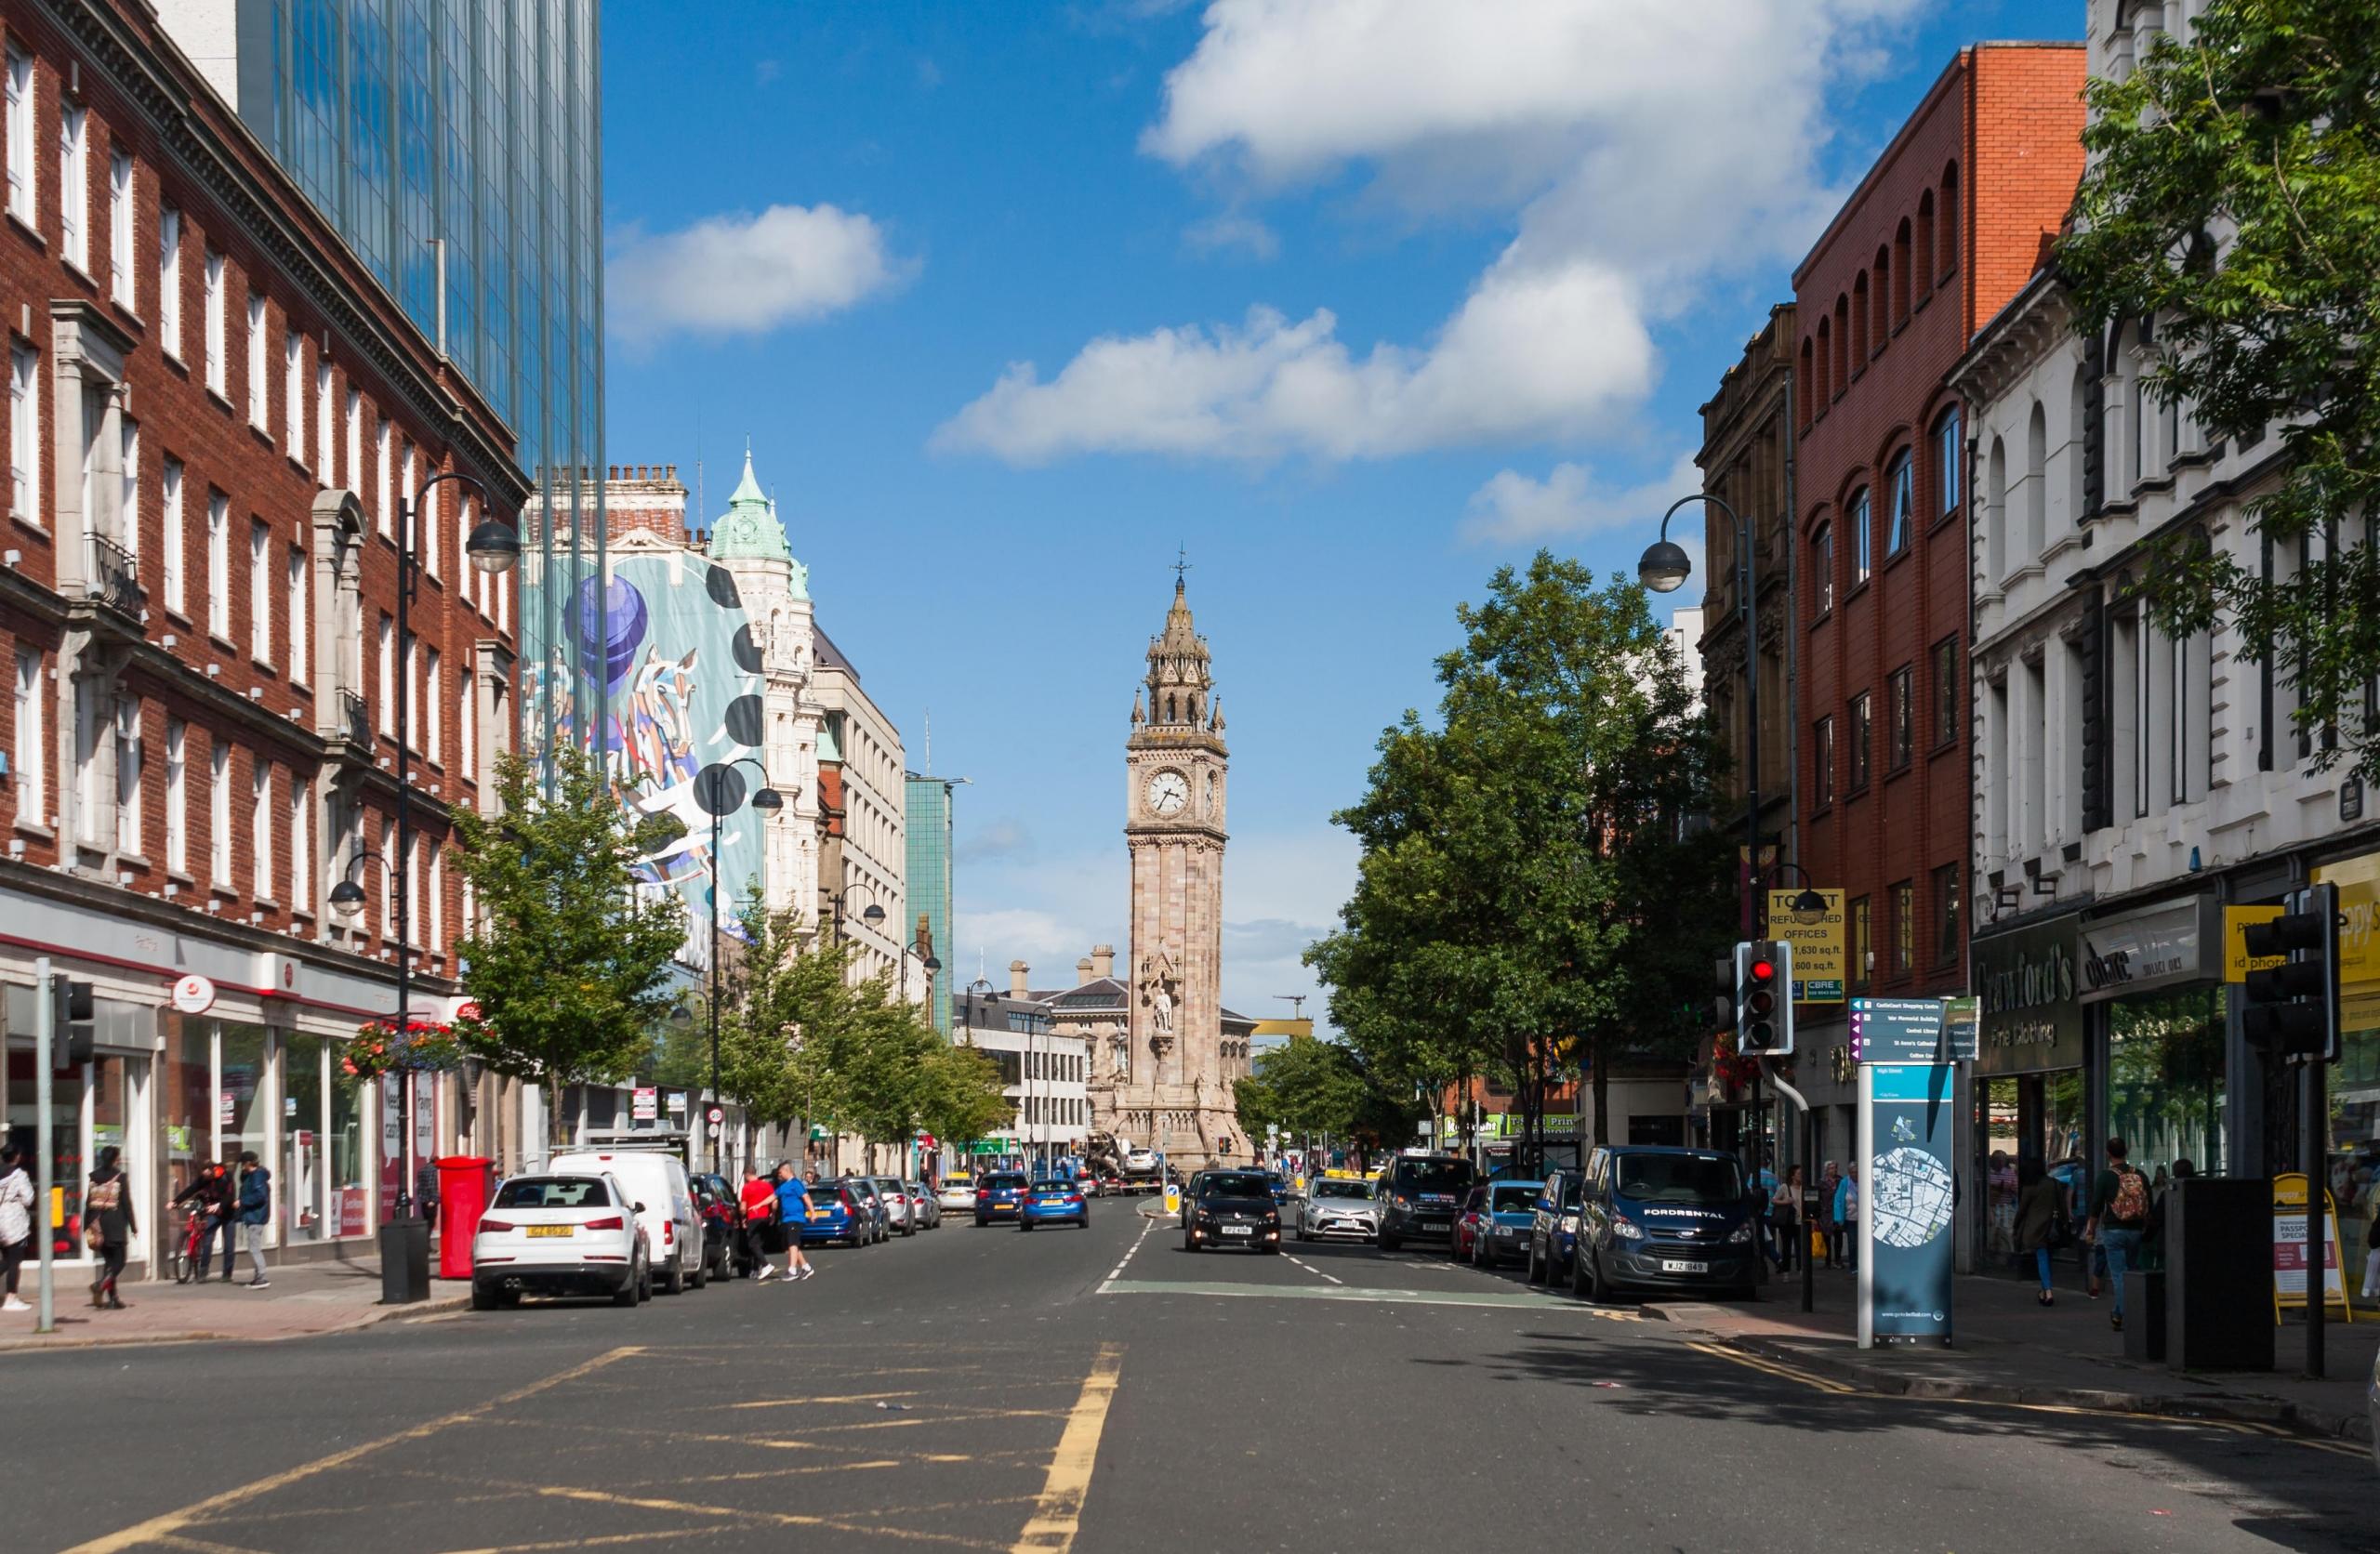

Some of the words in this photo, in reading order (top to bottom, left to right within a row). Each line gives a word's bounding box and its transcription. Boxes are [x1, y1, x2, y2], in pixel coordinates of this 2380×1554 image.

[1770, 915, 1842, 924] REFUHED
[1784, 929, 1828, 939] OFFICES
[1793, 946, 1818, 955] 1,630
[1819, 945, 1842, 955] sq.ft.
[1792, 962, 1813, 971] ,600
[1814, 961, 1837, 971] sq.ft.
[2142, 957, 2182, 977] SOLICIORS
[2234, 956, 2246, 968] id
[1977, 942, 2073, 1016] Crawford's
[1808, 981, 1834, 989] CBRE
[1644, 1209, 1726, 1219] FORDRENTAL
[1668, 1261, 1683, 1271] WJZ
[1685, 1262, 1703, 1271] 1849
